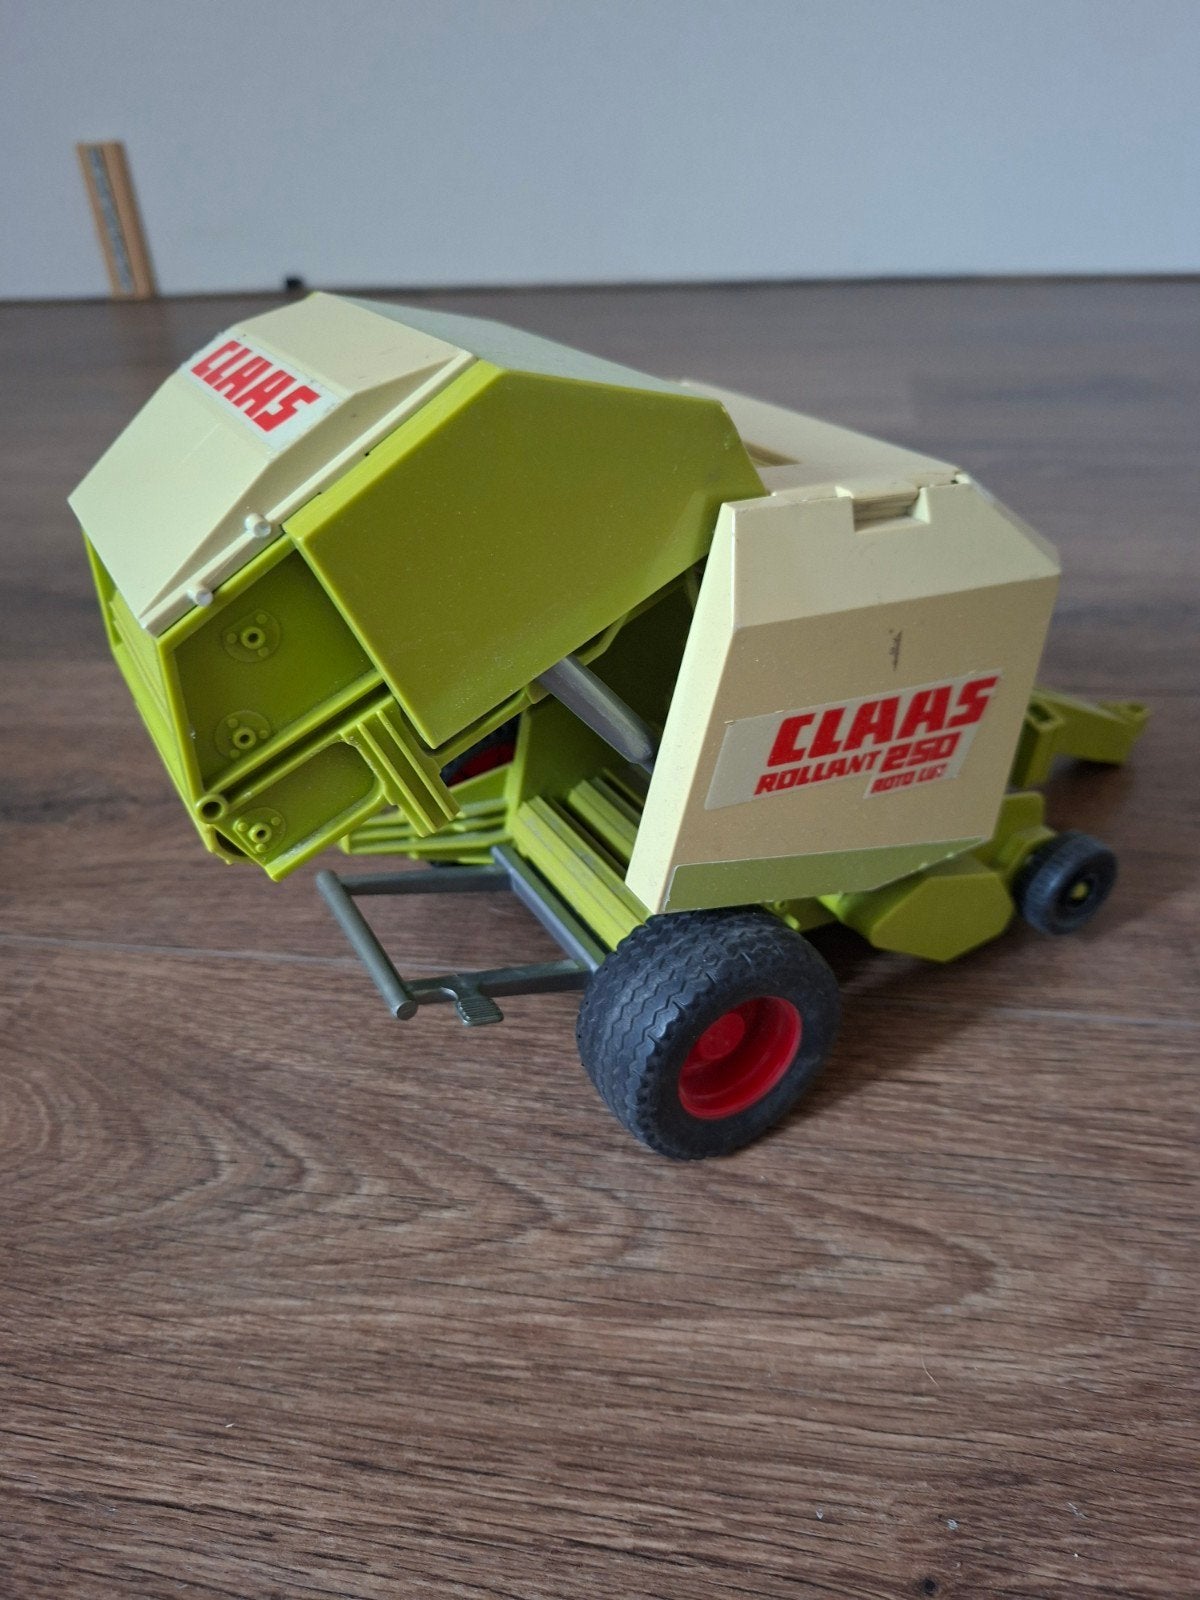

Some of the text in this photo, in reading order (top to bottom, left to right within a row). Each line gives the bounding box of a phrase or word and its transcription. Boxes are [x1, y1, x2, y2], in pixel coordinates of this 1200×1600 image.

[191, 340, 321, 432] CLAAS
[754, 732, 962, 794] ROLLANT 250
[767, 676, 997, 767] CLAAS
